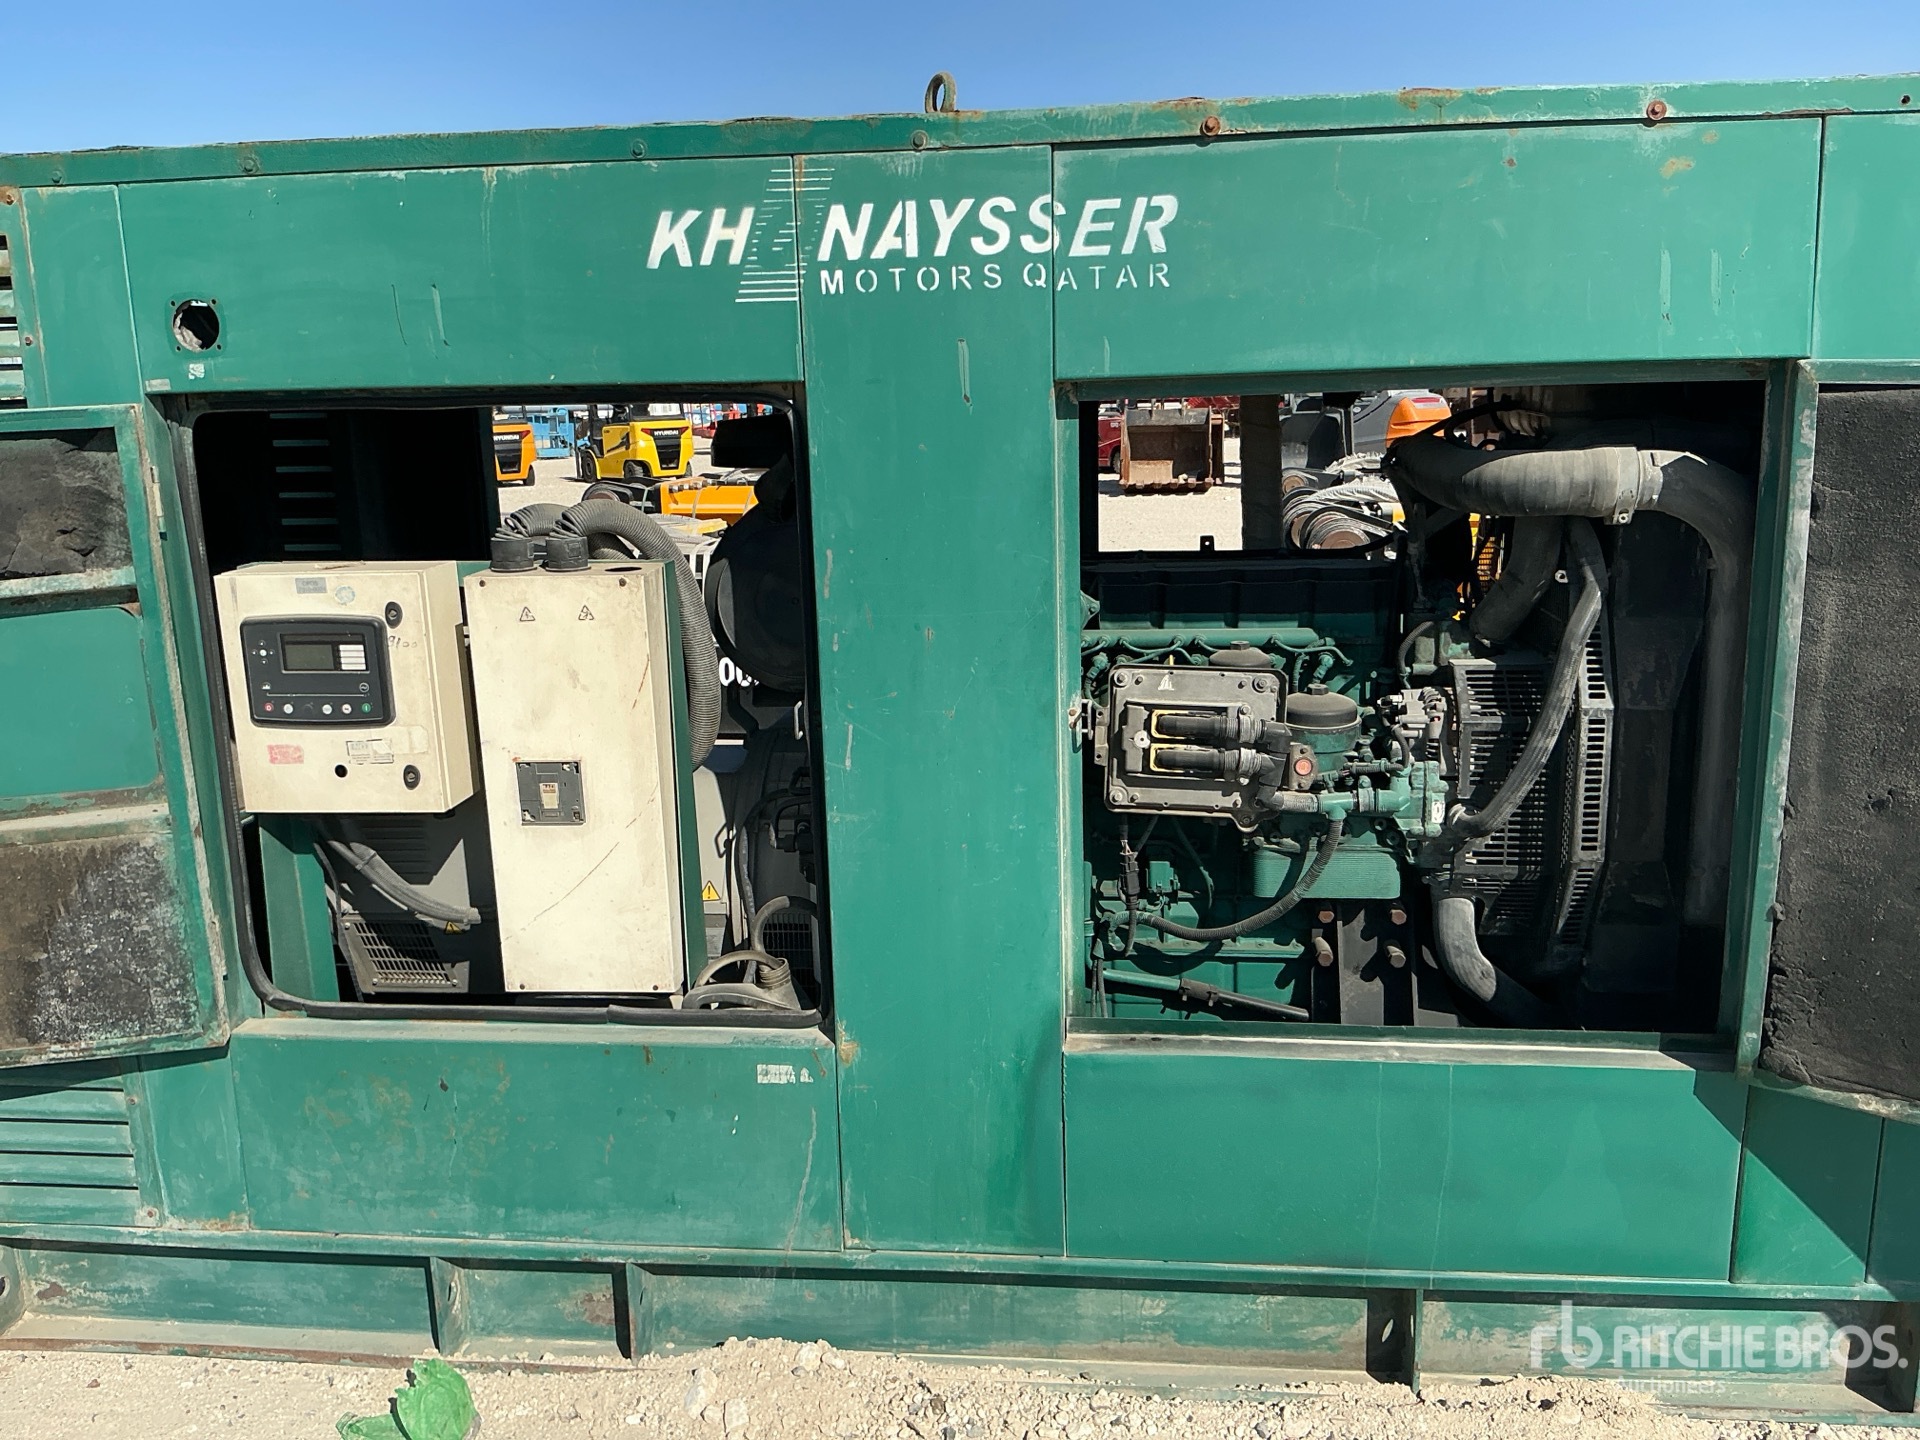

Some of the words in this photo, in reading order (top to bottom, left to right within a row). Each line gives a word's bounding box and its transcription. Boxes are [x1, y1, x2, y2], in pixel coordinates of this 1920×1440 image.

[818, 195, 1178, 261] NAYSSER
[821, 264, 1002, 295] MOTORS
[1023, 262, 1170, 291] QATAR
